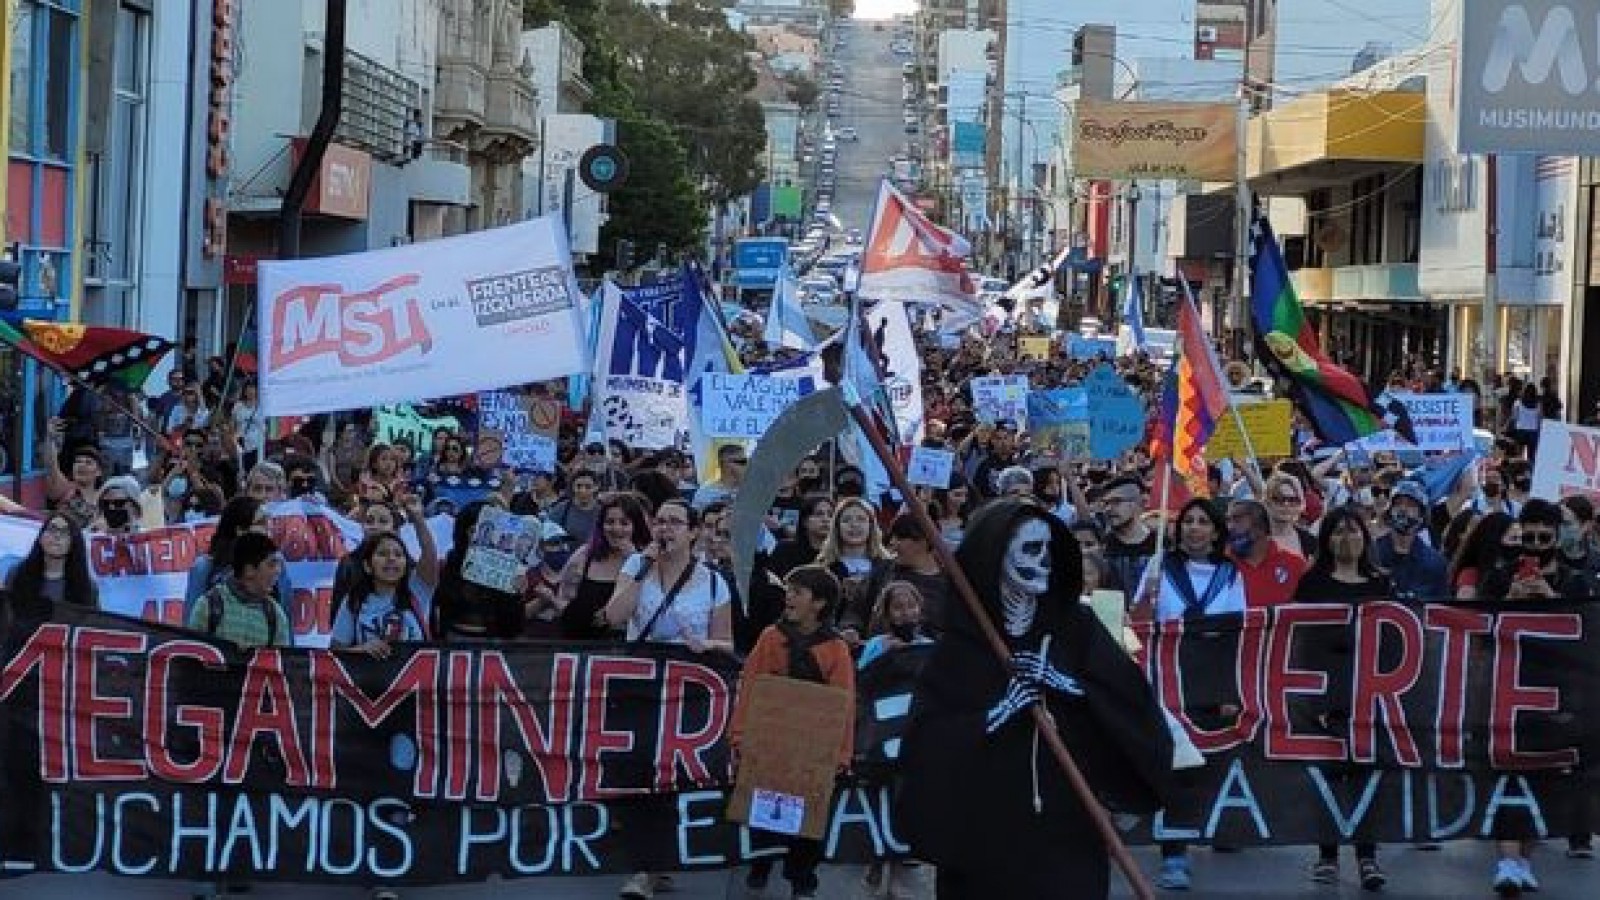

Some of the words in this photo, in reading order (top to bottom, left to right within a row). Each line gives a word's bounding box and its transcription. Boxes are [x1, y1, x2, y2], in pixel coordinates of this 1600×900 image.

[471, 273, 541, 300] FRENTE
[277, 281, 424, 360] MST
[712, 374, 734, 391] EL
[741, 375, 797, 396] AGUA
[723, 392, 768, 413] VALE
[1129, 601, 1582, 768] UERTE
[2, 788, 413, 876] UCHAMOS
[457, 803, 608, 875] POR
[1307, 765, 1549, 839] VIDA
